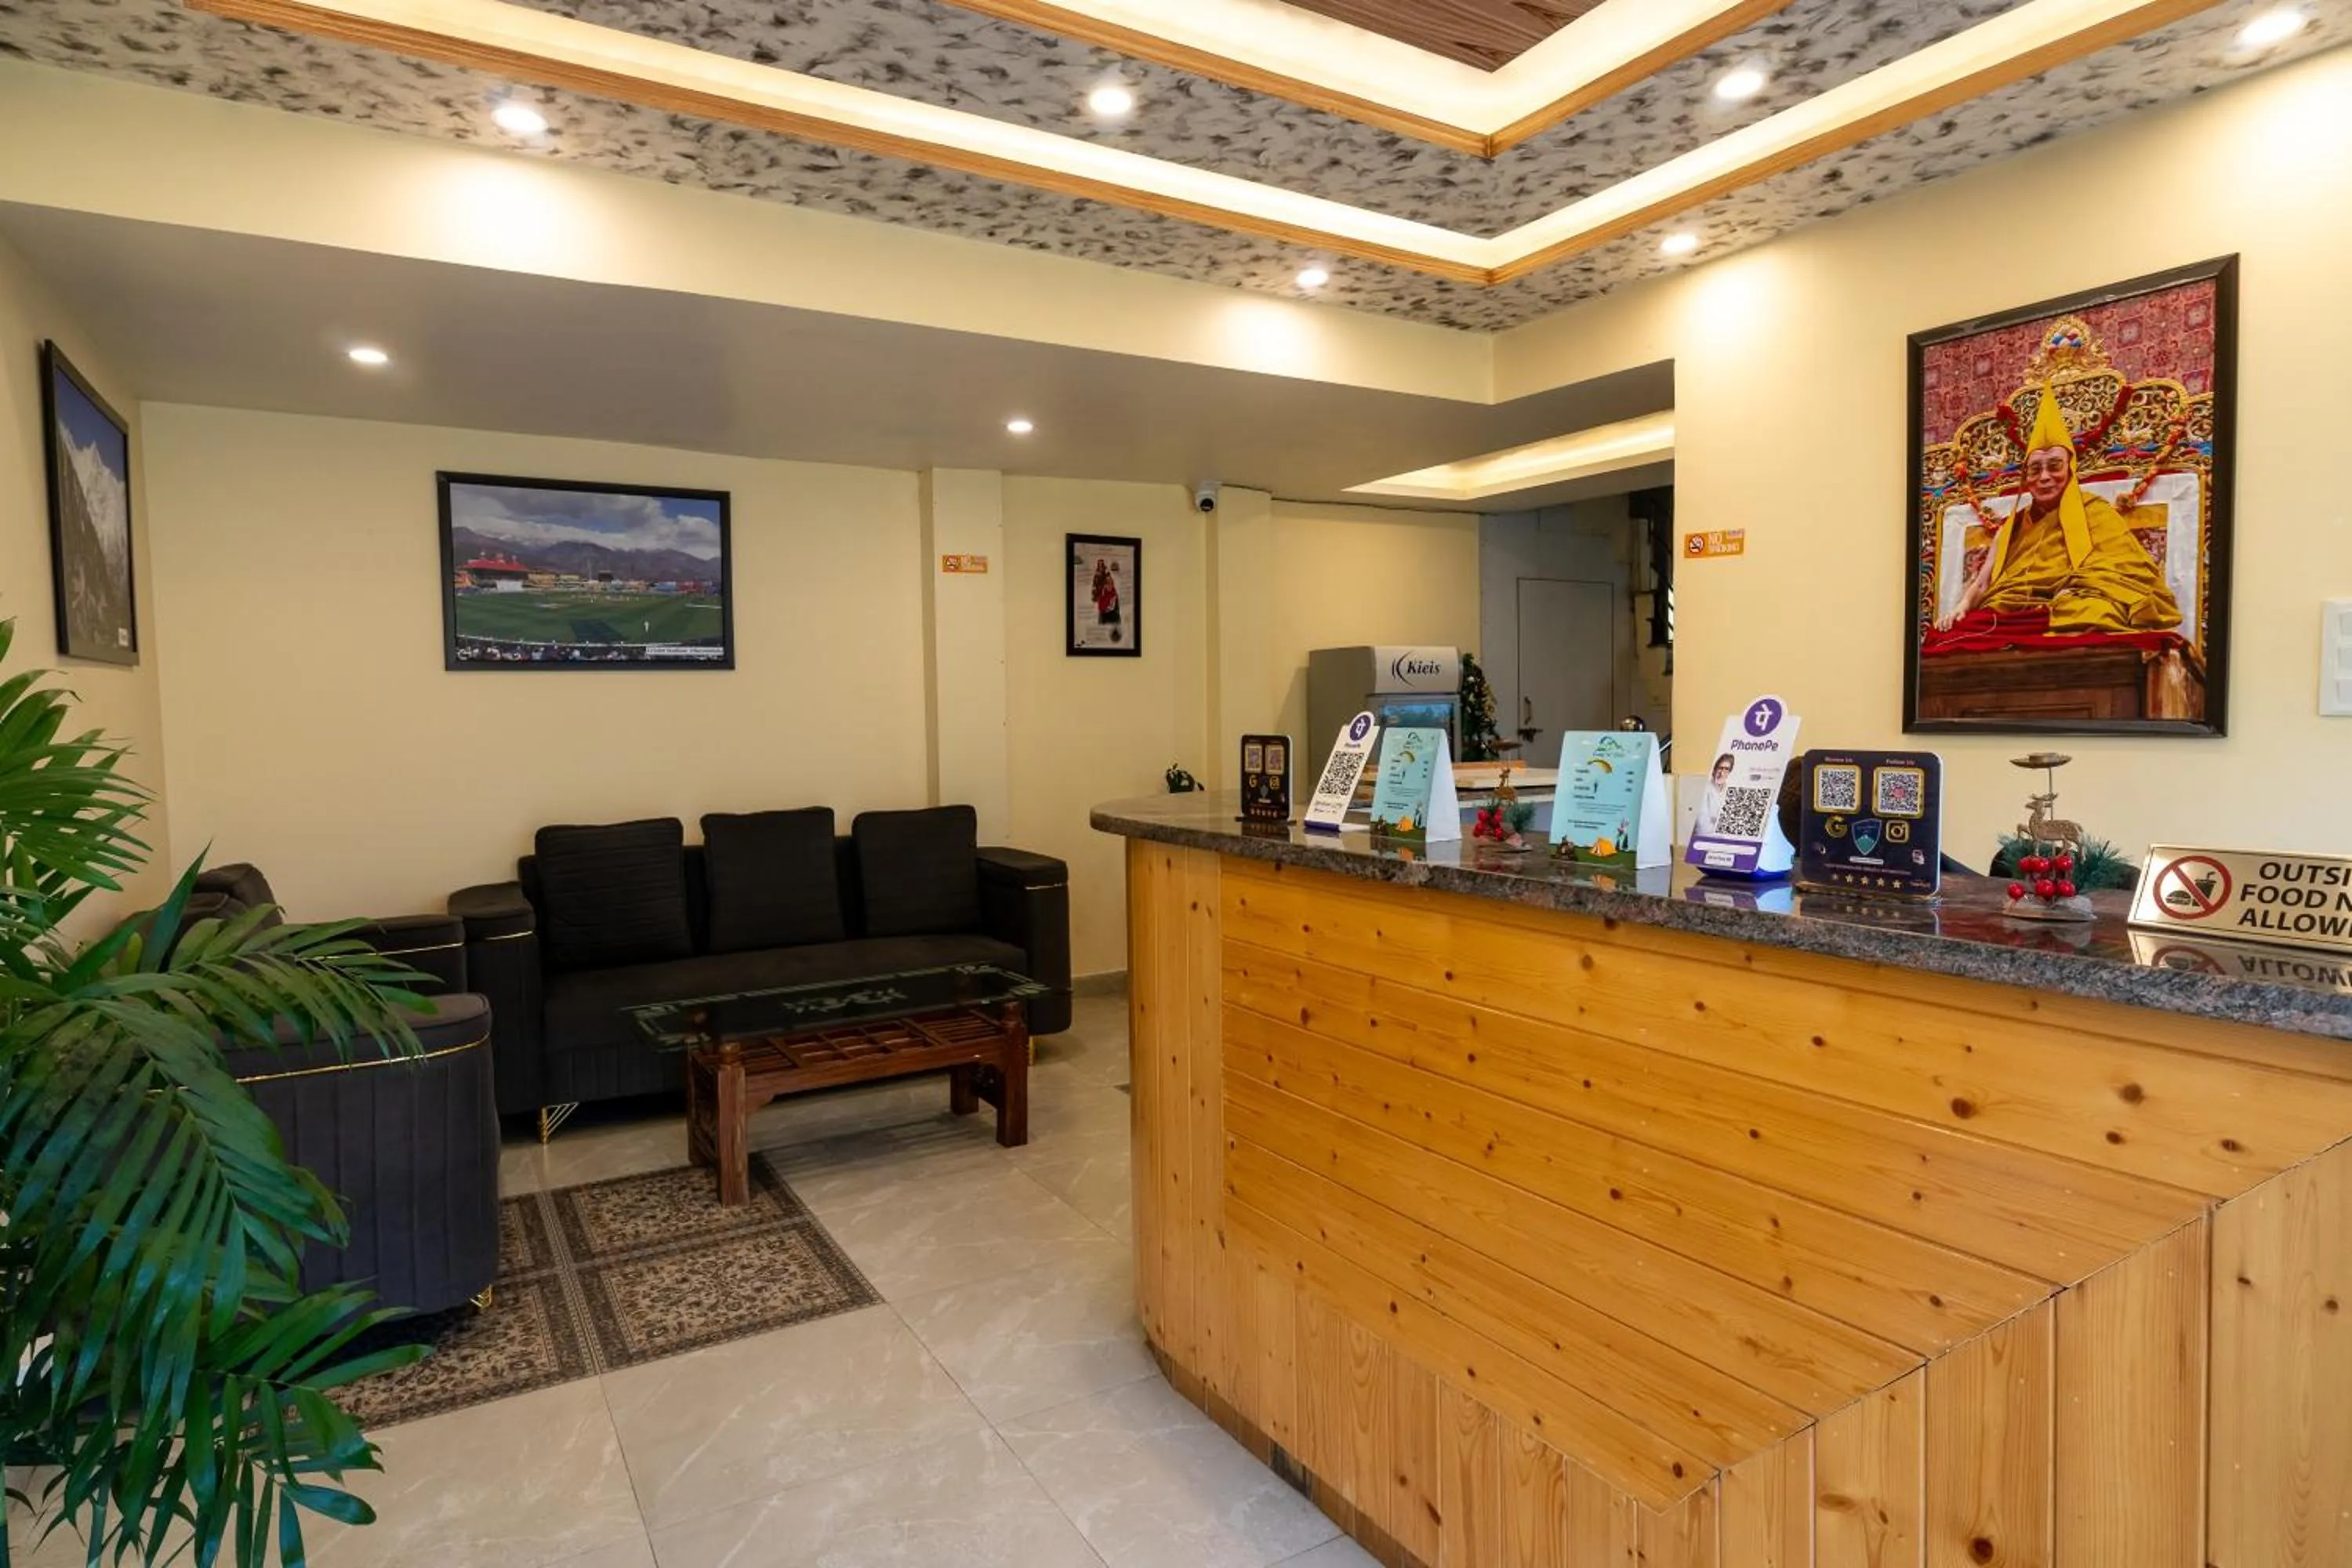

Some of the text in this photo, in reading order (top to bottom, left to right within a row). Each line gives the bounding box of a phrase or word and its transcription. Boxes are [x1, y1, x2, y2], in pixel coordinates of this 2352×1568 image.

[1731, 739, 1779, 751] PhonePe
[2259, 862, 2352, 887] OUTSI
[2240, 884, 2328, 909] FOOD
[2237, 907, 2352, 938] ALLOW
